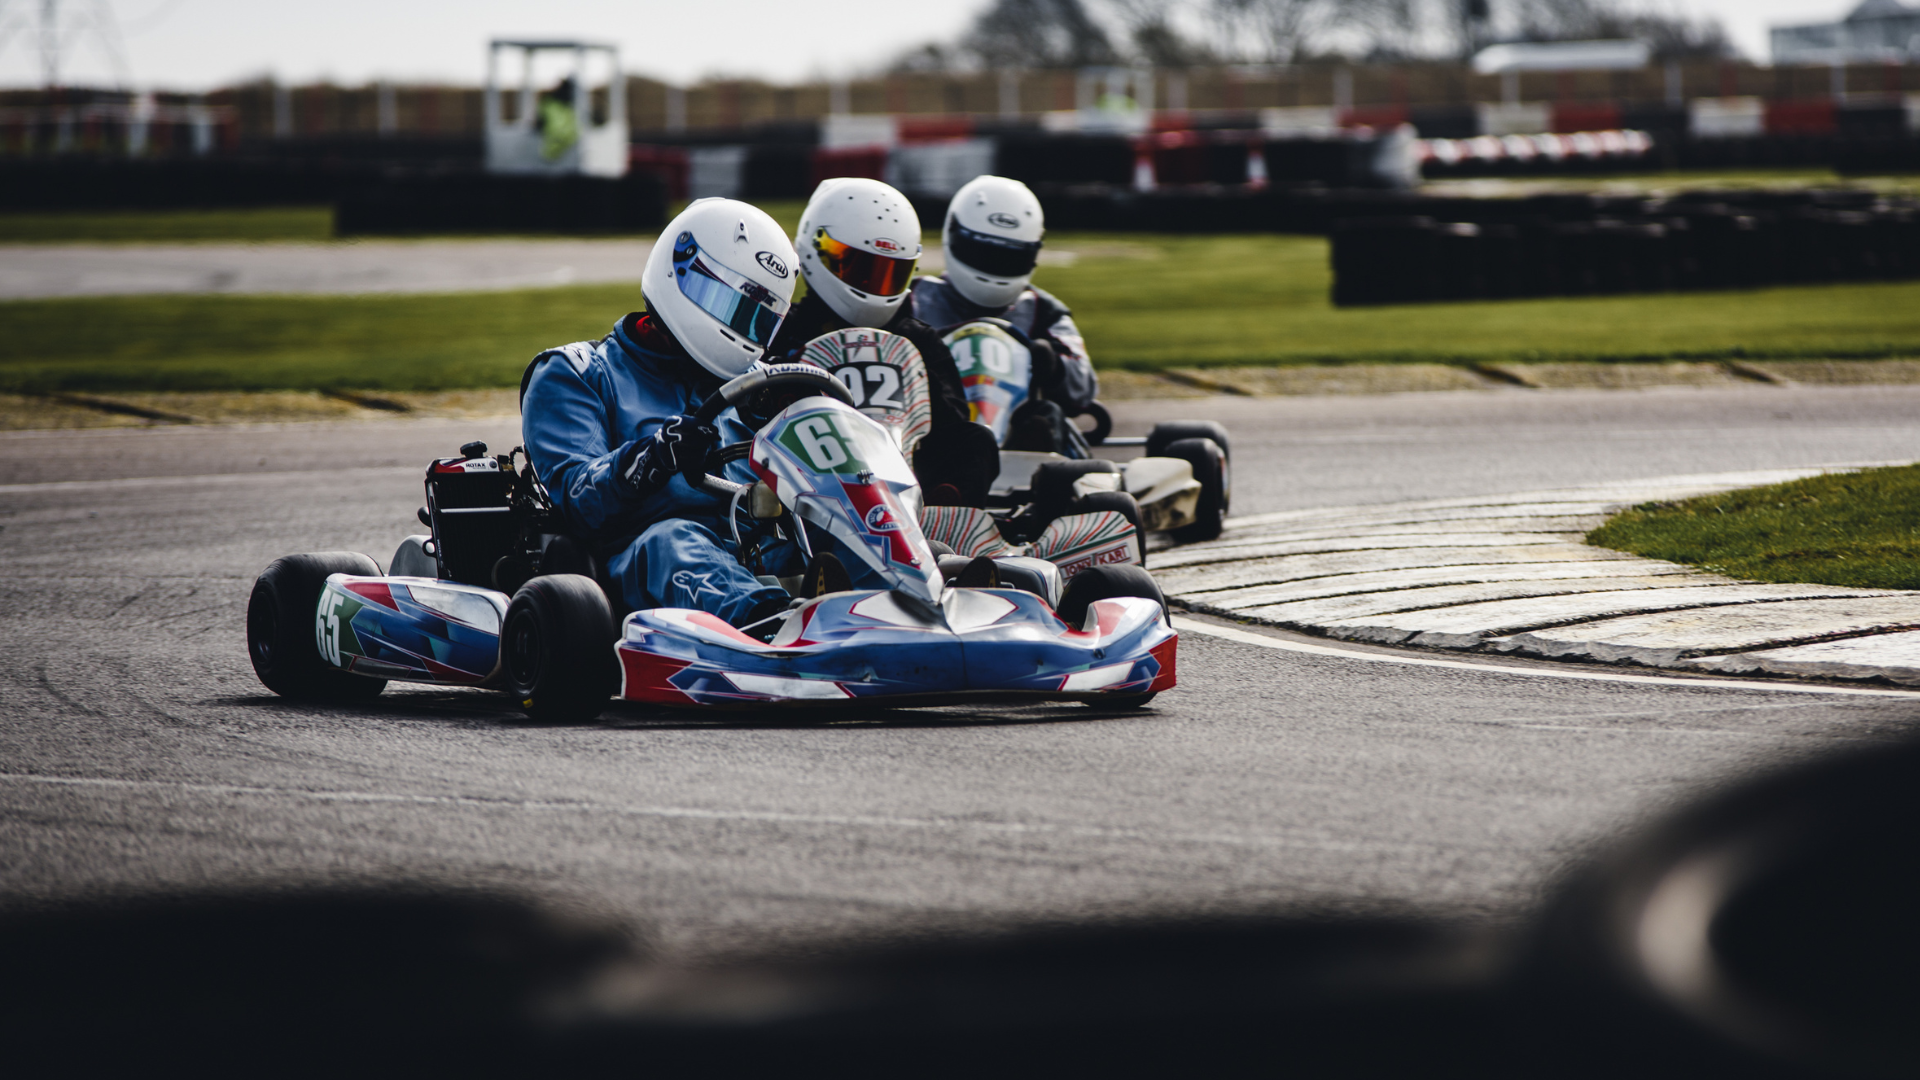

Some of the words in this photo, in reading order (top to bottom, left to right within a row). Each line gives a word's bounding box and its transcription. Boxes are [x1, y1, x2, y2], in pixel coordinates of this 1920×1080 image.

[875, 240, 897, 251] BELL
[759, 252, 787, 276] Arai
[950, 337, 1010, 374] 40
[1096, 545, 1130, 565] KART
[315, 589, 345, 667] 65
